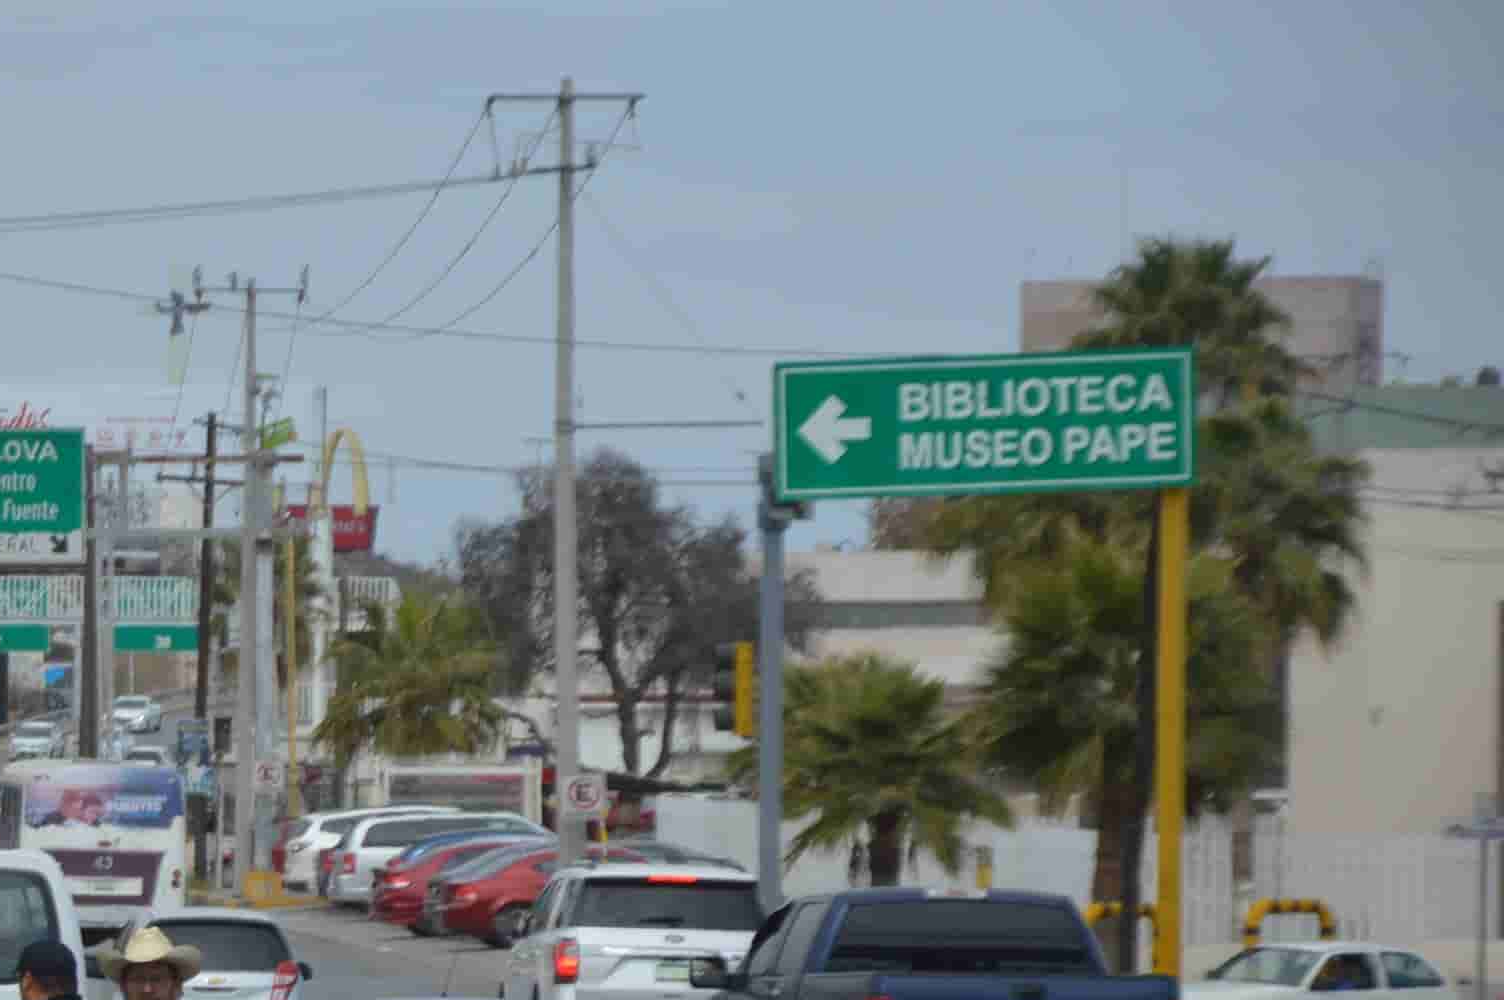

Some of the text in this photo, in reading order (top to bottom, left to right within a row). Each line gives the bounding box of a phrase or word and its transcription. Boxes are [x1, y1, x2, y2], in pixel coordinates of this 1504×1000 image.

[898, 373, 1174, 421] BIBLIOTECA
[898, 421, 1177, 471] MUSEO PAPE
[2, 498, 60, 521] Fuente
